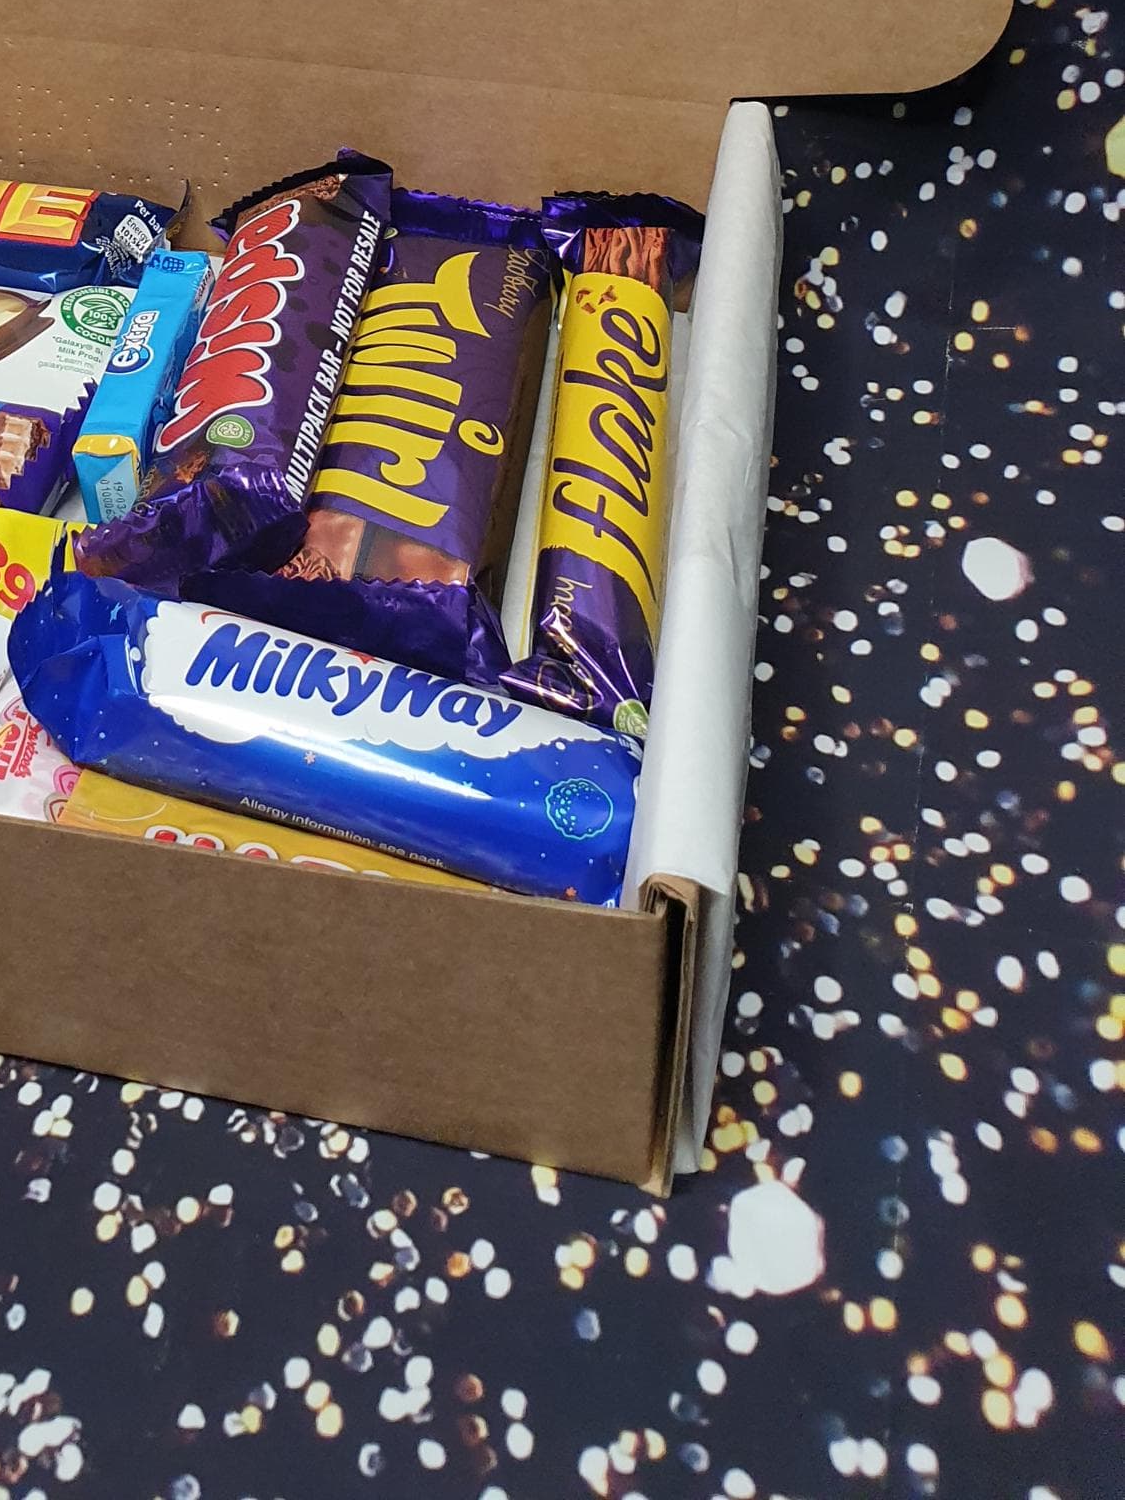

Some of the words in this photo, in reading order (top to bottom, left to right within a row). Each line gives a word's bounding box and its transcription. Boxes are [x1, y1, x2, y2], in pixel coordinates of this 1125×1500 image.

[126, 217, 150, 244] Energy
[134, 199, 151, 218] Per
[352, 210, 381, 278] RESALE
[343, 260, 368, 308] FOR
[111, 311, 160, 368] extra
[156, 199, 305, 452] Wispa
[330, 297, 356, 342] NOT
[312, 250, 505, 528] Twirl
[315, 348, 342, 397] BAR
[284, 382, 331, 503] MULTIPACK
[238, 795, 289, 822] Allergy
[377, 840, 407, 857] see
